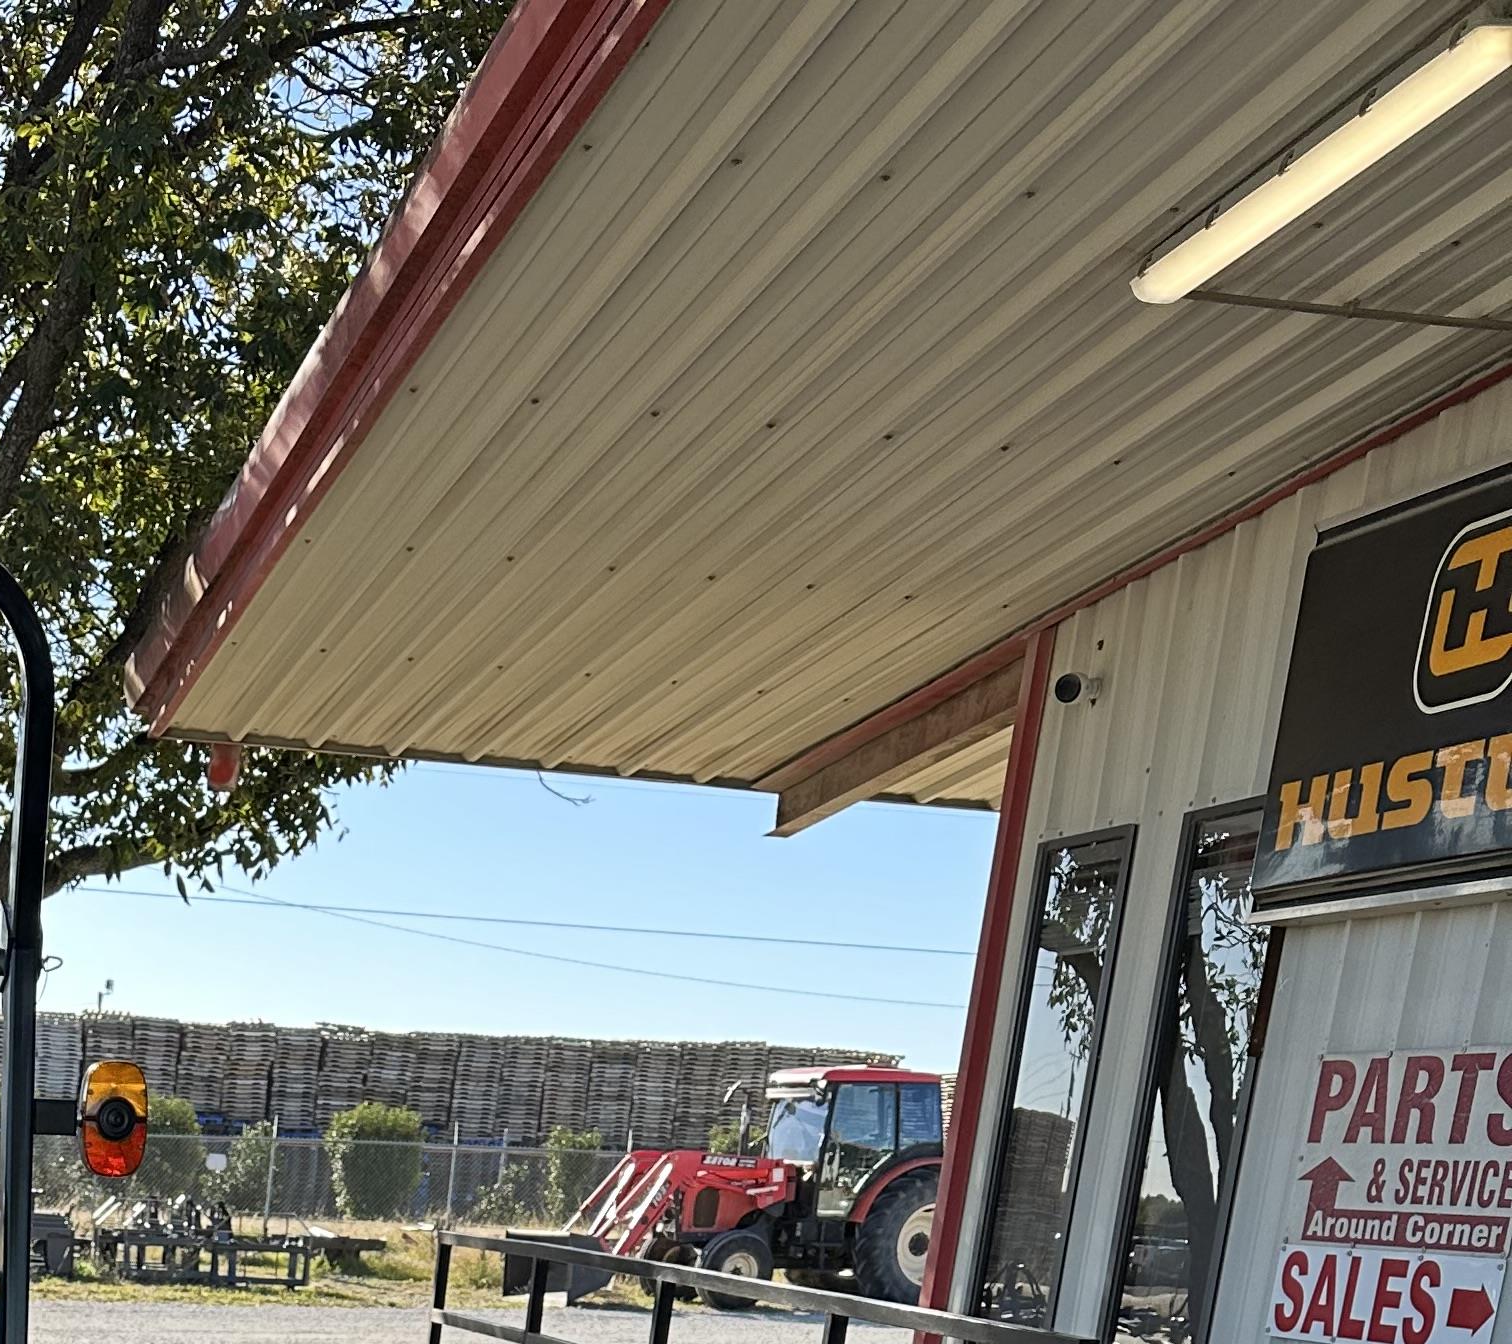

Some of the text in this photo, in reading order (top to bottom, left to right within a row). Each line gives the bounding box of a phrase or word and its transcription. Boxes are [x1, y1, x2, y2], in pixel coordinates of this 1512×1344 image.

[1307, 1052, 1512, 1147] PARTS
[1366, 1158, 1512, 1209] & SERVICE
[1306, 1210, 1504, 1248] Around Corner
